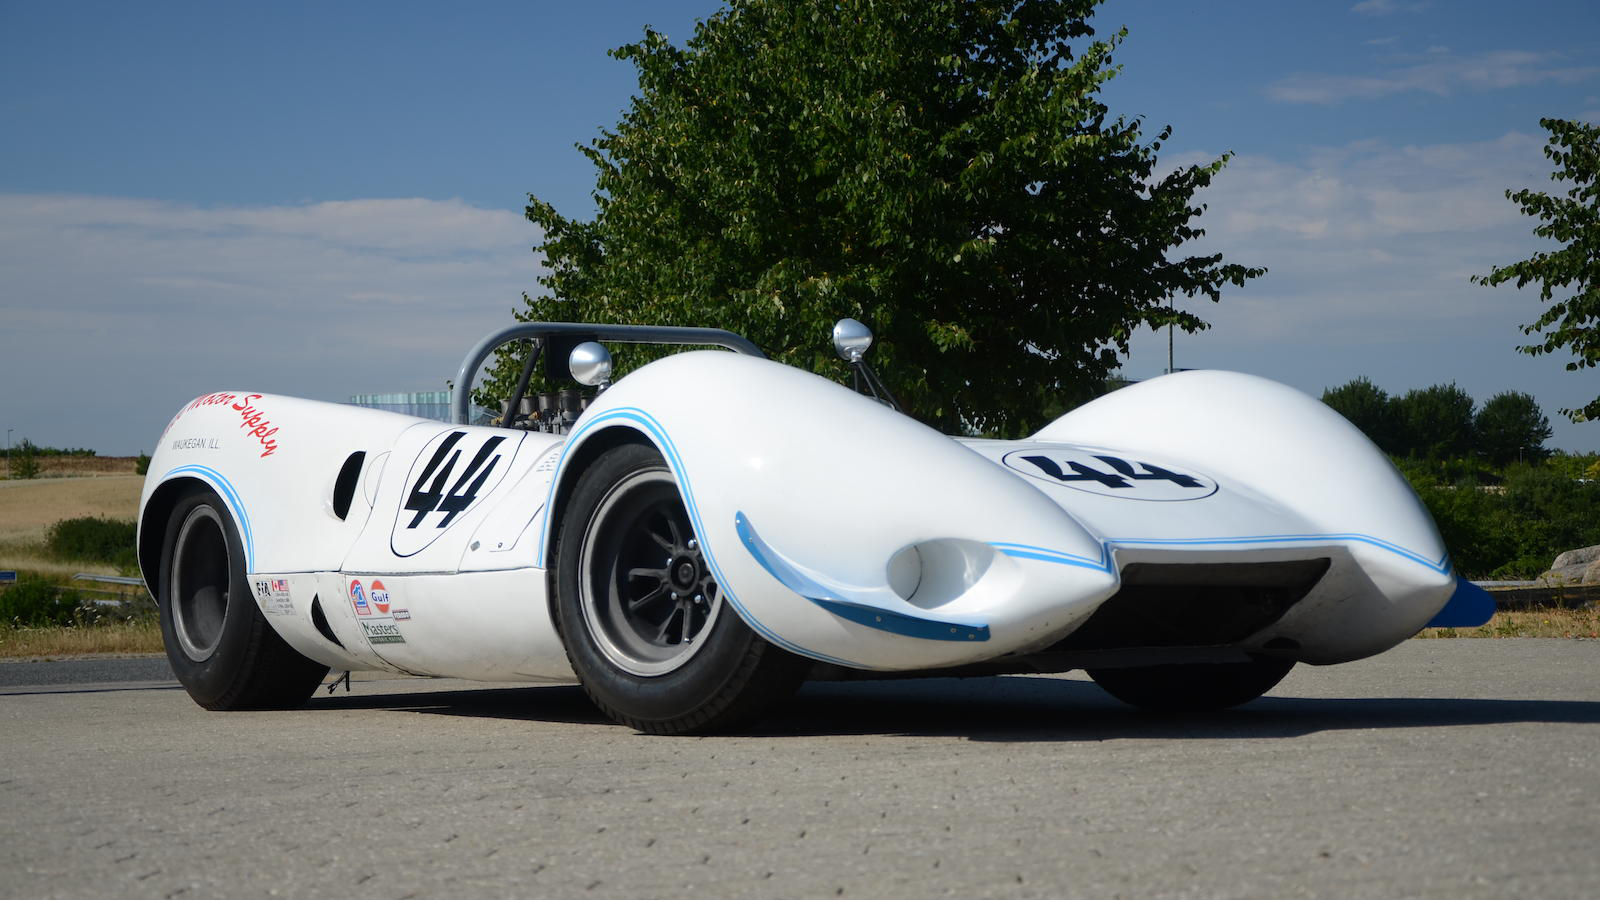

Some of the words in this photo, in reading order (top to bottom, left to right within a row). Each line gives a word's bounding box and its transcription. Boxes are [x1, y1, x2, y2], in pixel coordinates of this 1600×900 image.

[232, 394, 280, 458] Supply
[404, 431, 509, 529] 44
[1019, 455, 1206, 489] 44
[371, 591, 389, 602] Gulf
[361, 621, 399, 636] Masters
